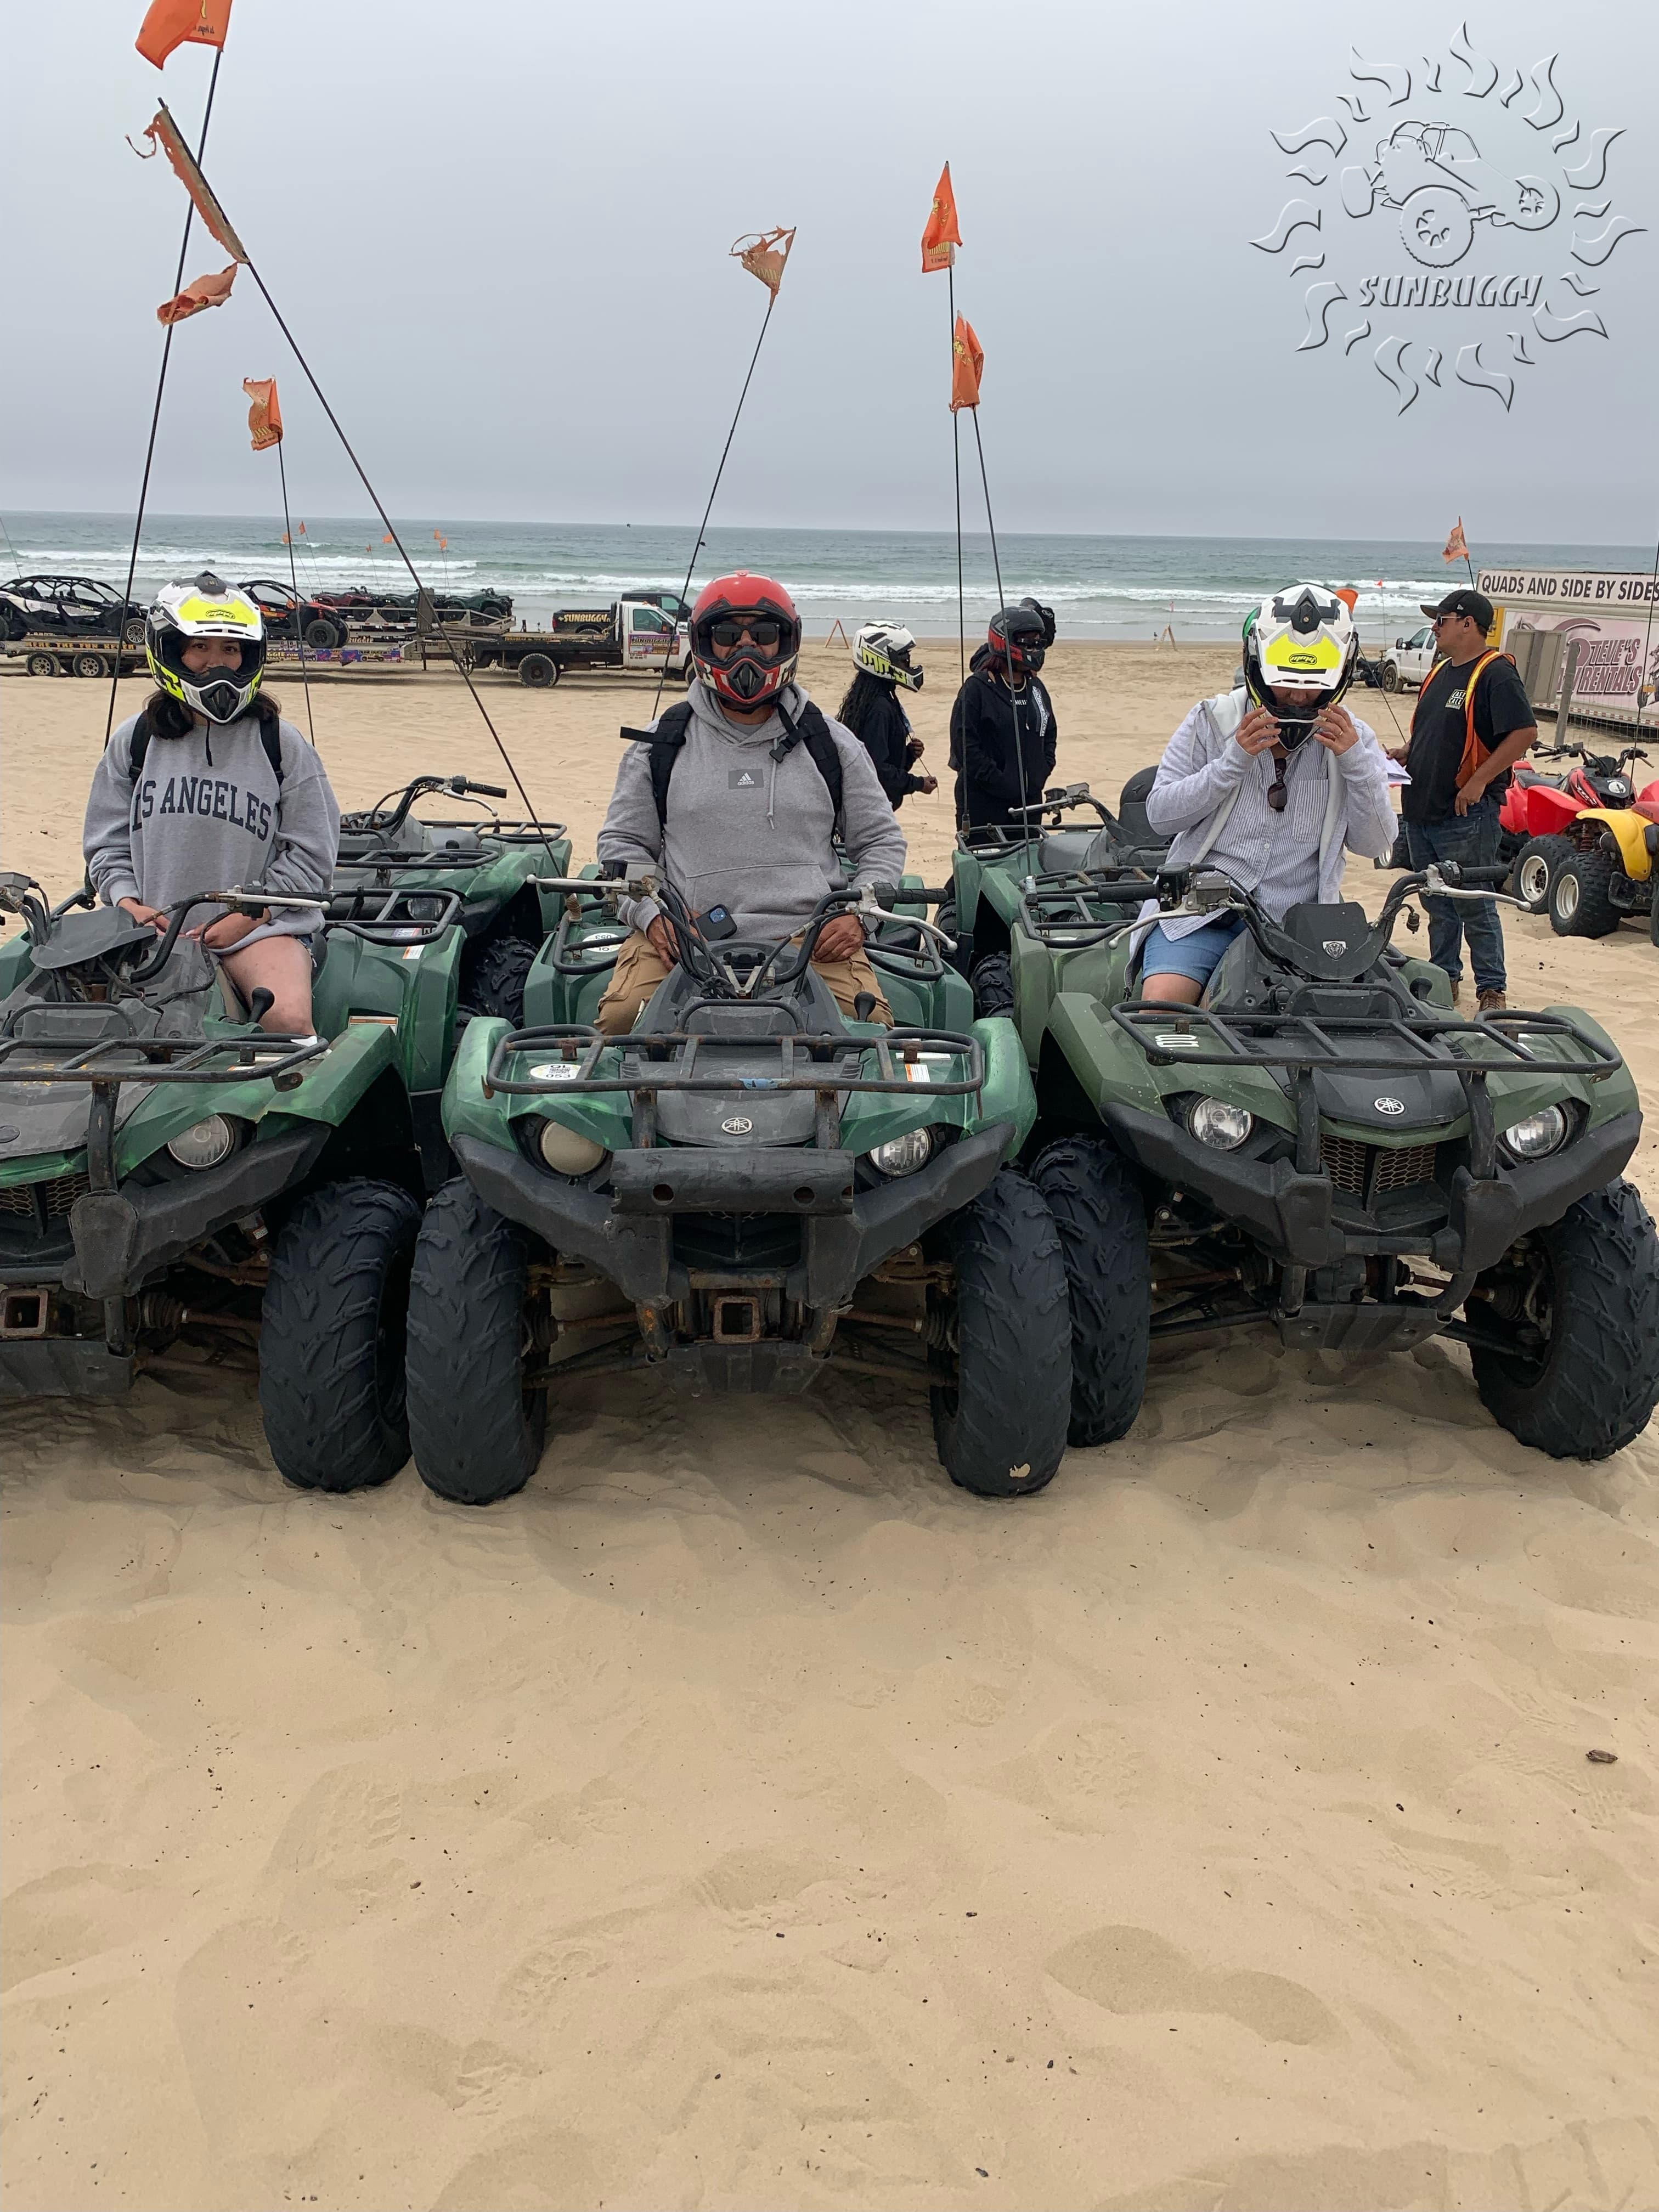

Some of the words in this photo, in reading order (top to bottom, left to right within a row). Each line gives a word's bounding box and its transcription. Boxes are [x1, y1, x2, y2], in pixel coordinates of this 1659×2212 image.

[1482, 575, 1525, 594] QUADS
[1527, 577, 1558, 596] AND
[1561, 579, 1592, 598] SIDE
[1595, 579, 1616, 599] BY
[1578, 665, 1643, 694] RENTALS
[1452, 691, 1466, 699] LAST
[160, 776, 272, 842] ANGELES
